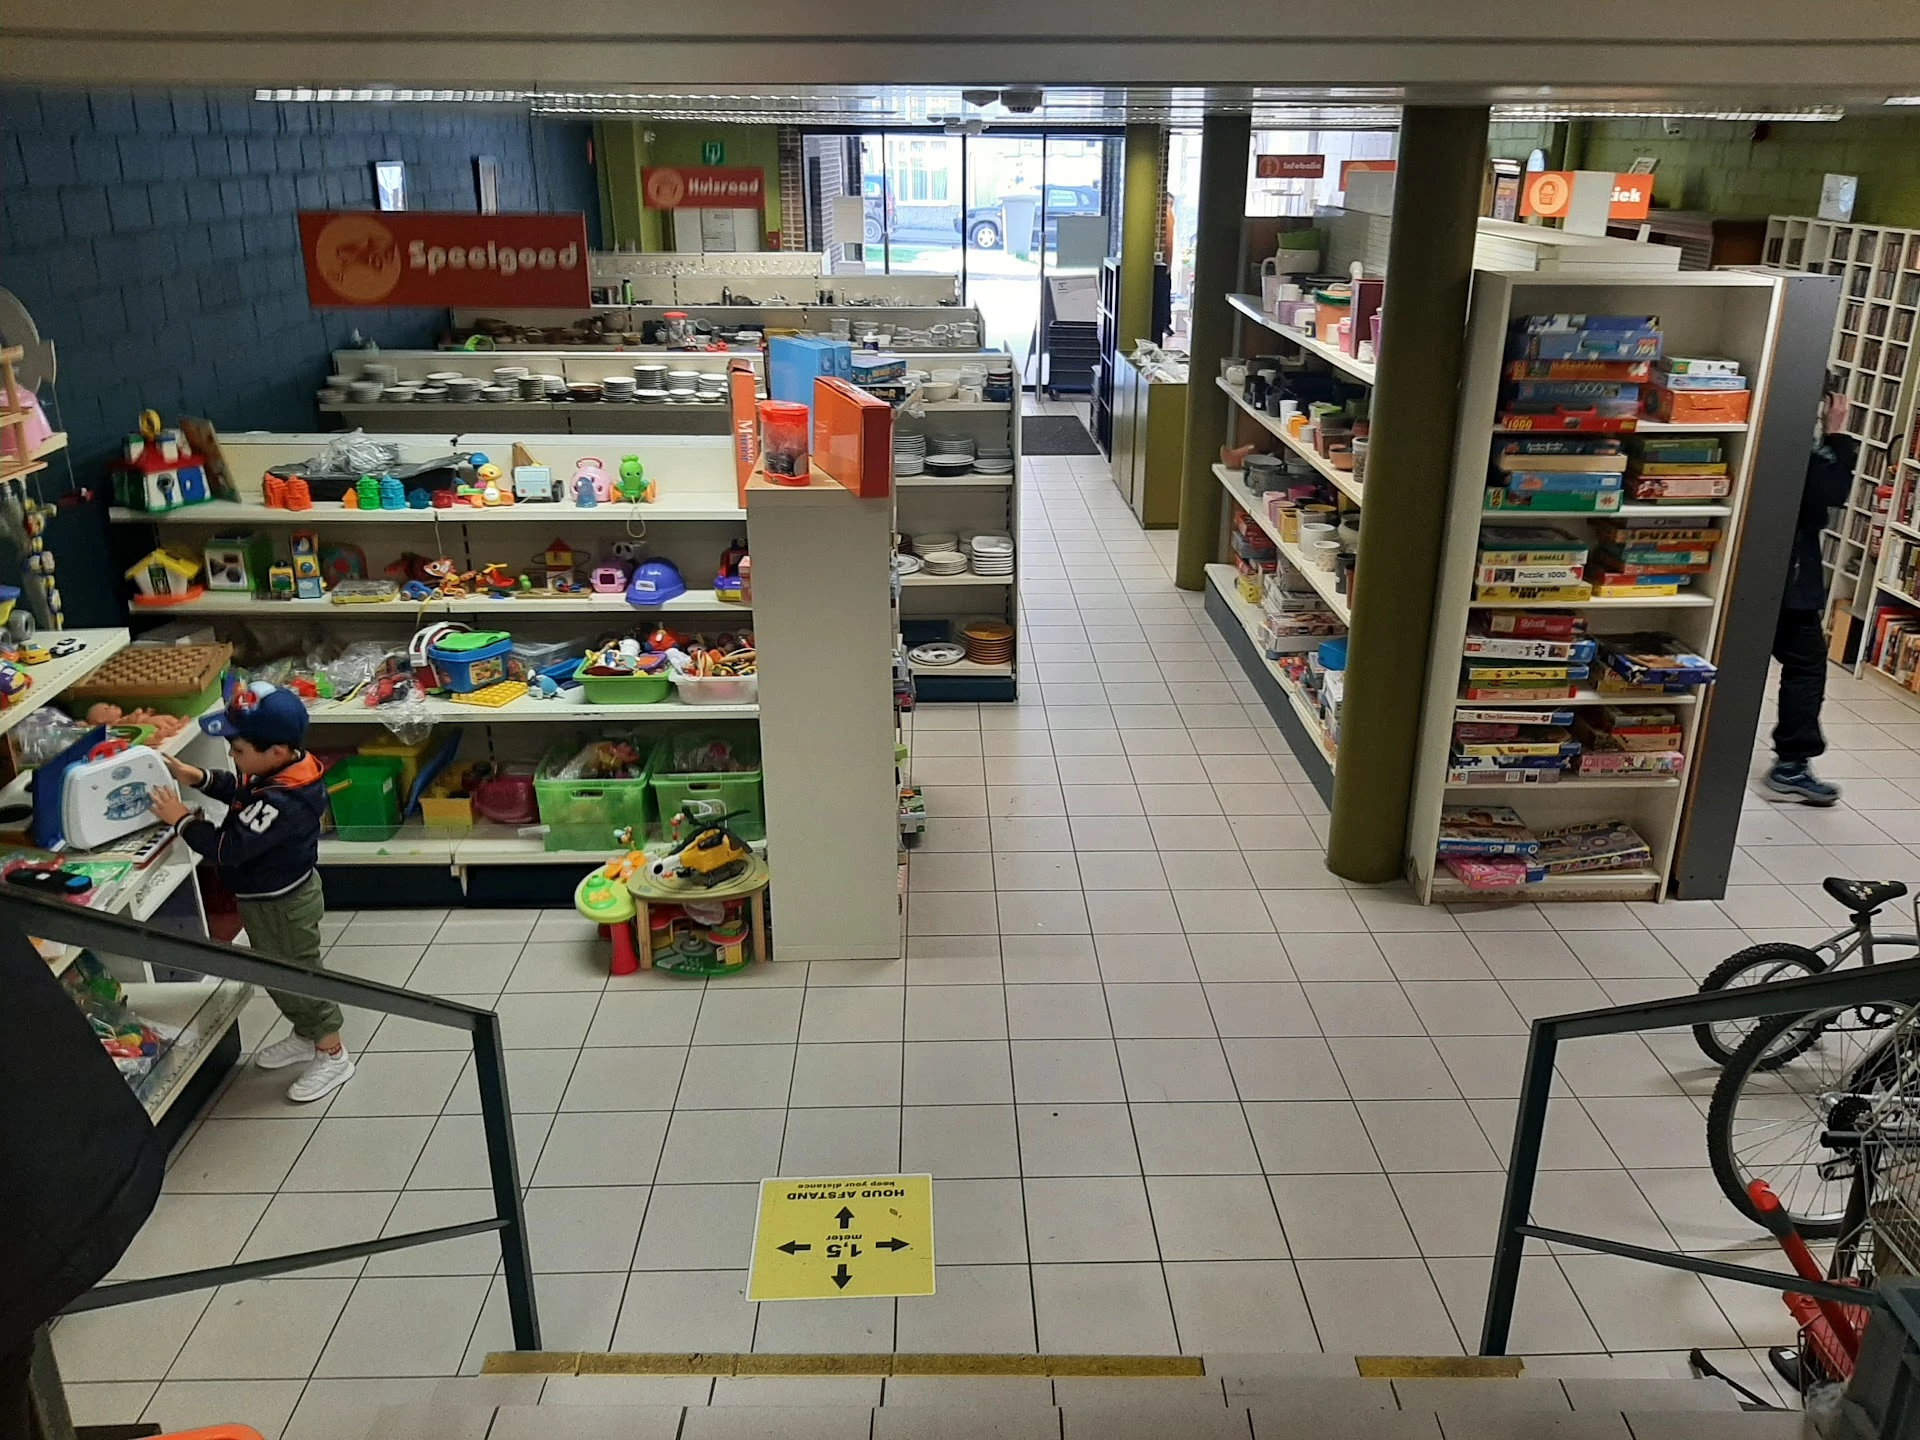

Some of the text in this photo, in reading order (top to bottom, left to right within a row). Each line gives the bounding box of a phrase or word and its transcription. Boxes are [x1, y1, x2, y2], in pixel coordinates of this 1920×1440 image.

[1283, 161, 1322, 170] Infobalie
[688, 177, 759, 197] Huisraad
[408, 239, 578, 276] Speelgoed
[1638, 531, 1703, 540] PUZZLE
[1518, 571, 1567, 579] Puzzle 1000
[238, 799, 279, 834] 03
[786, 1189, 905, 1200] HOUD AFSTAND
[826, 1241, 863, 1258] 1,5
